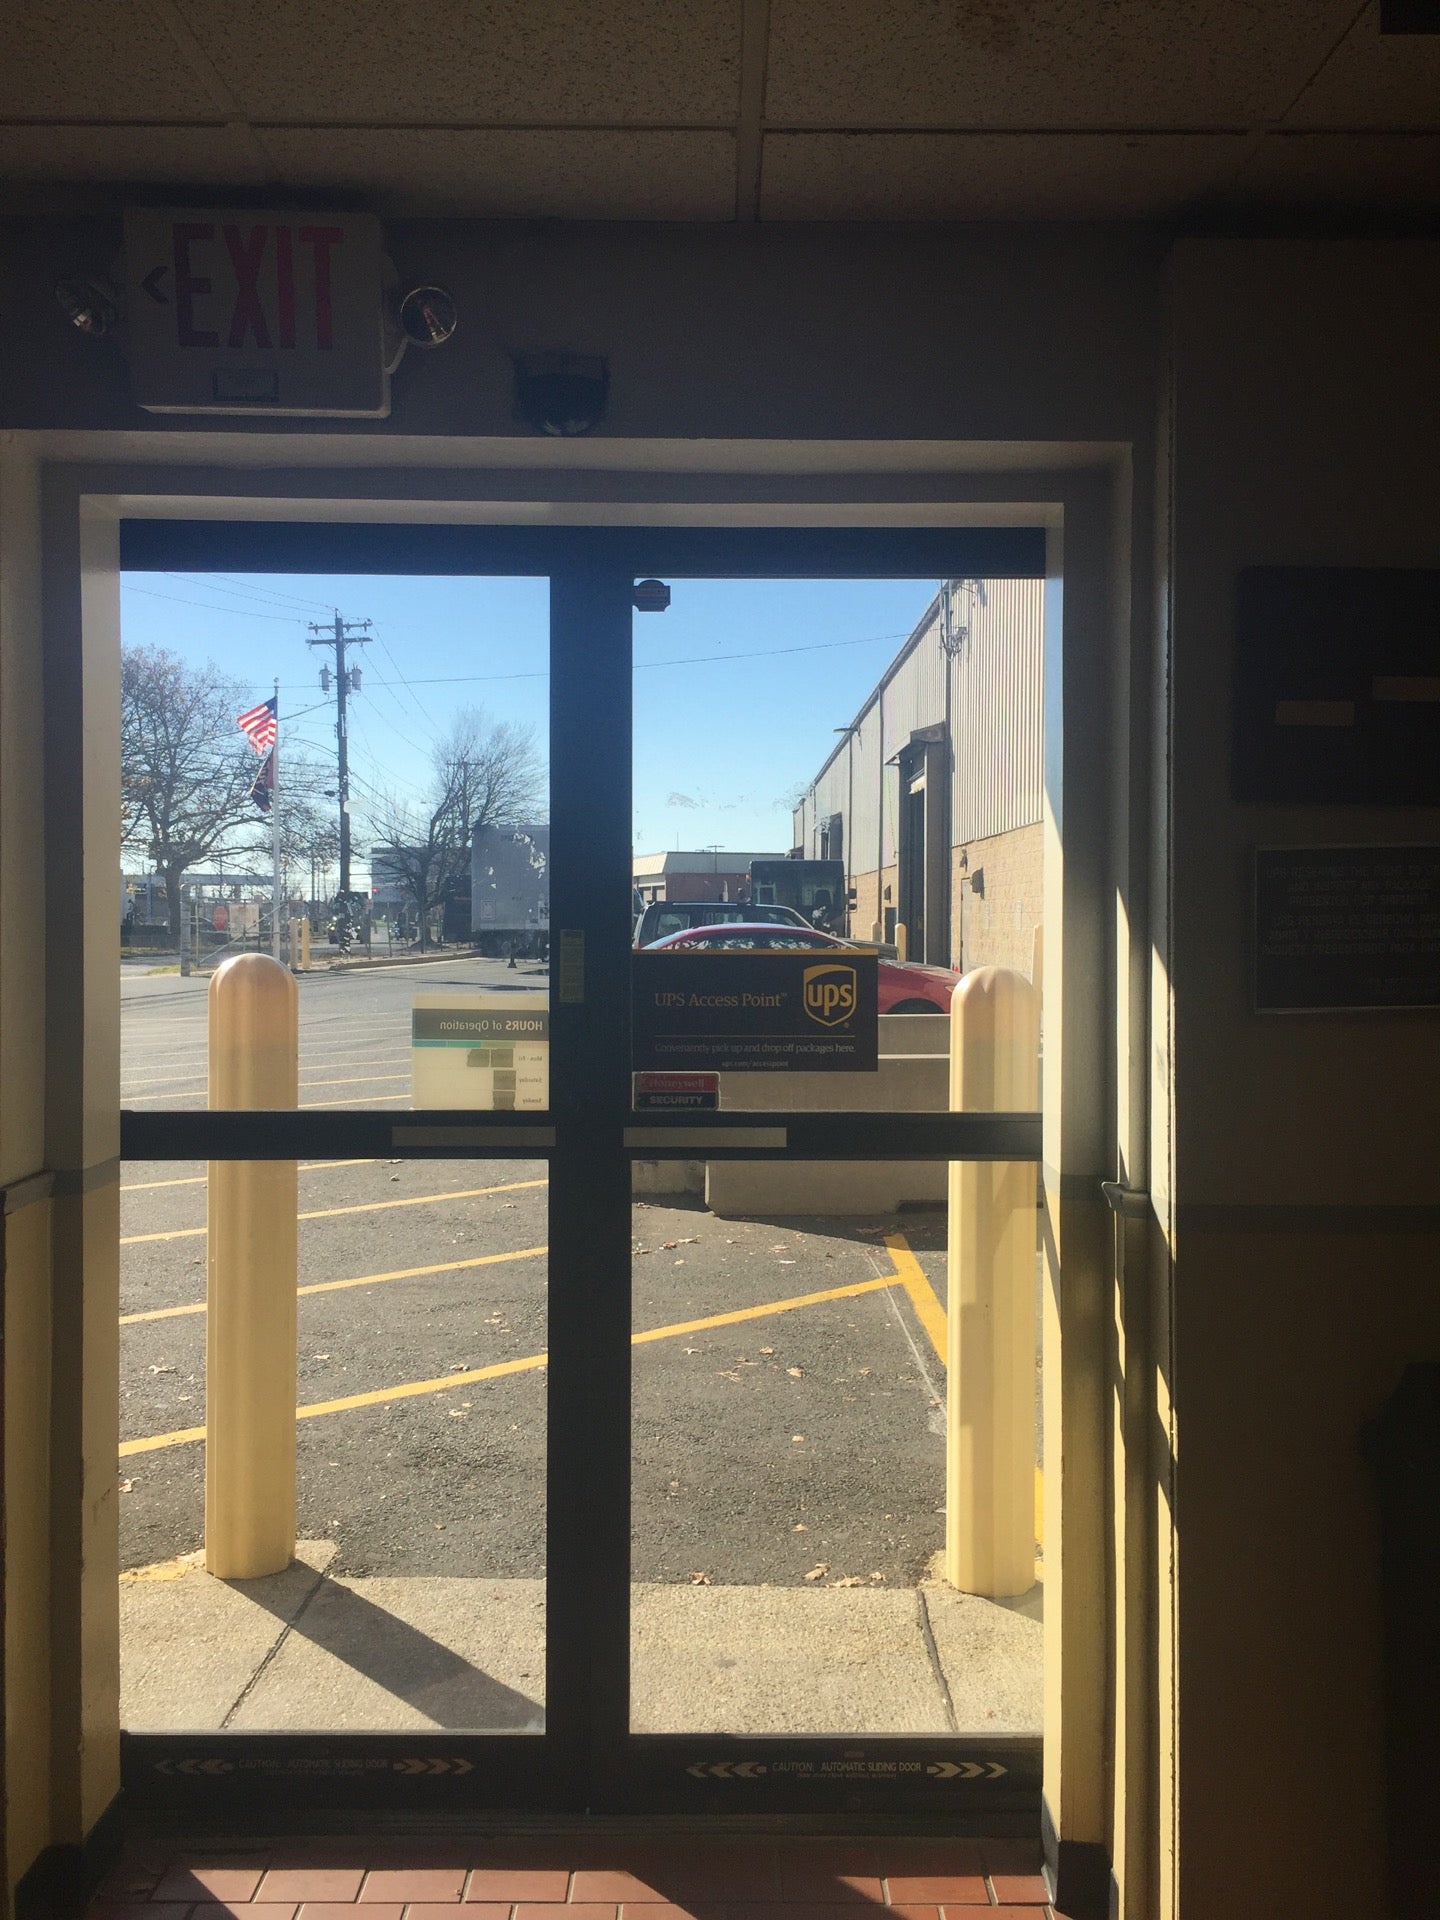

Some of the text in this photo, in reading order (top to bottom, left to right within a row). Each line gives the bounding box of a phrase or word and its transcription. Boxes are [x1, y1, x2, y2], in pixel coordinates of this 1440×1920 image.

[173, 223, 343, 350] EXIT
[655, 992, 685, 1008] UPS
[689, 992, 738, 1008] Access
[654, 1043, 709, 1054] Conveniently
[711, 1043, 729, 1054] pick
[731, 1044, 743, 1054] up
[744, 1043, 760, 1053] and
[761, 1043, 782, 1054] drop
[782, 1042, 794, 1053] off
[795, 1042, 834, 1054] packages
[648, 1078, 705, 1089] Honeywell
[649, 1095, 703, 1104] SECURITY
[820, 1762, 866, 1772] AUTOMATIC
[868, 1762, 896, 1772] SLIDING
[898, 1762, 922, 1772] DOOR
